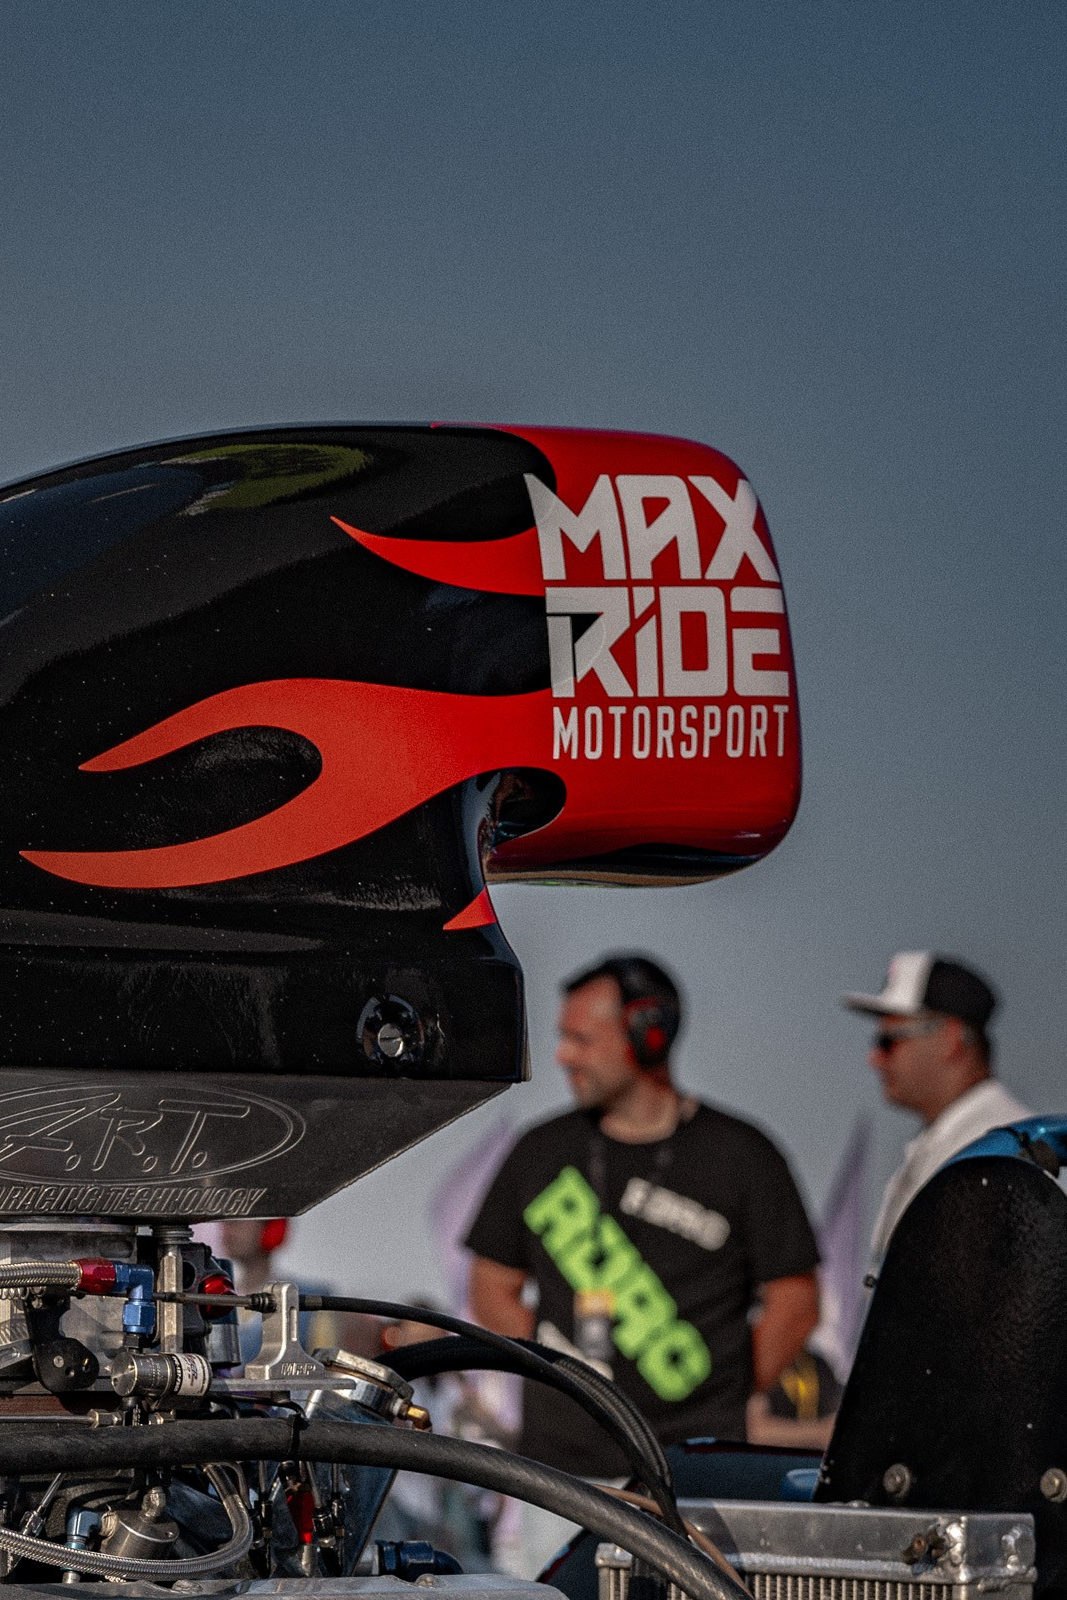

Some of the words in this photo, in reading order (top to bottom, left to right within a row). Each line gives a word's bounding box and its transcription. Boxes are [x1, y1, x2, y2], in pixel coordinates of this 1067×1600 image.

[524, 473, 781, 581] MAX
[545, 586, 790, 698] RIDE
[553, 704, 790, 760] MOTORSPORT
[101, 1187, 268, 1216] TECHNOLOGY
